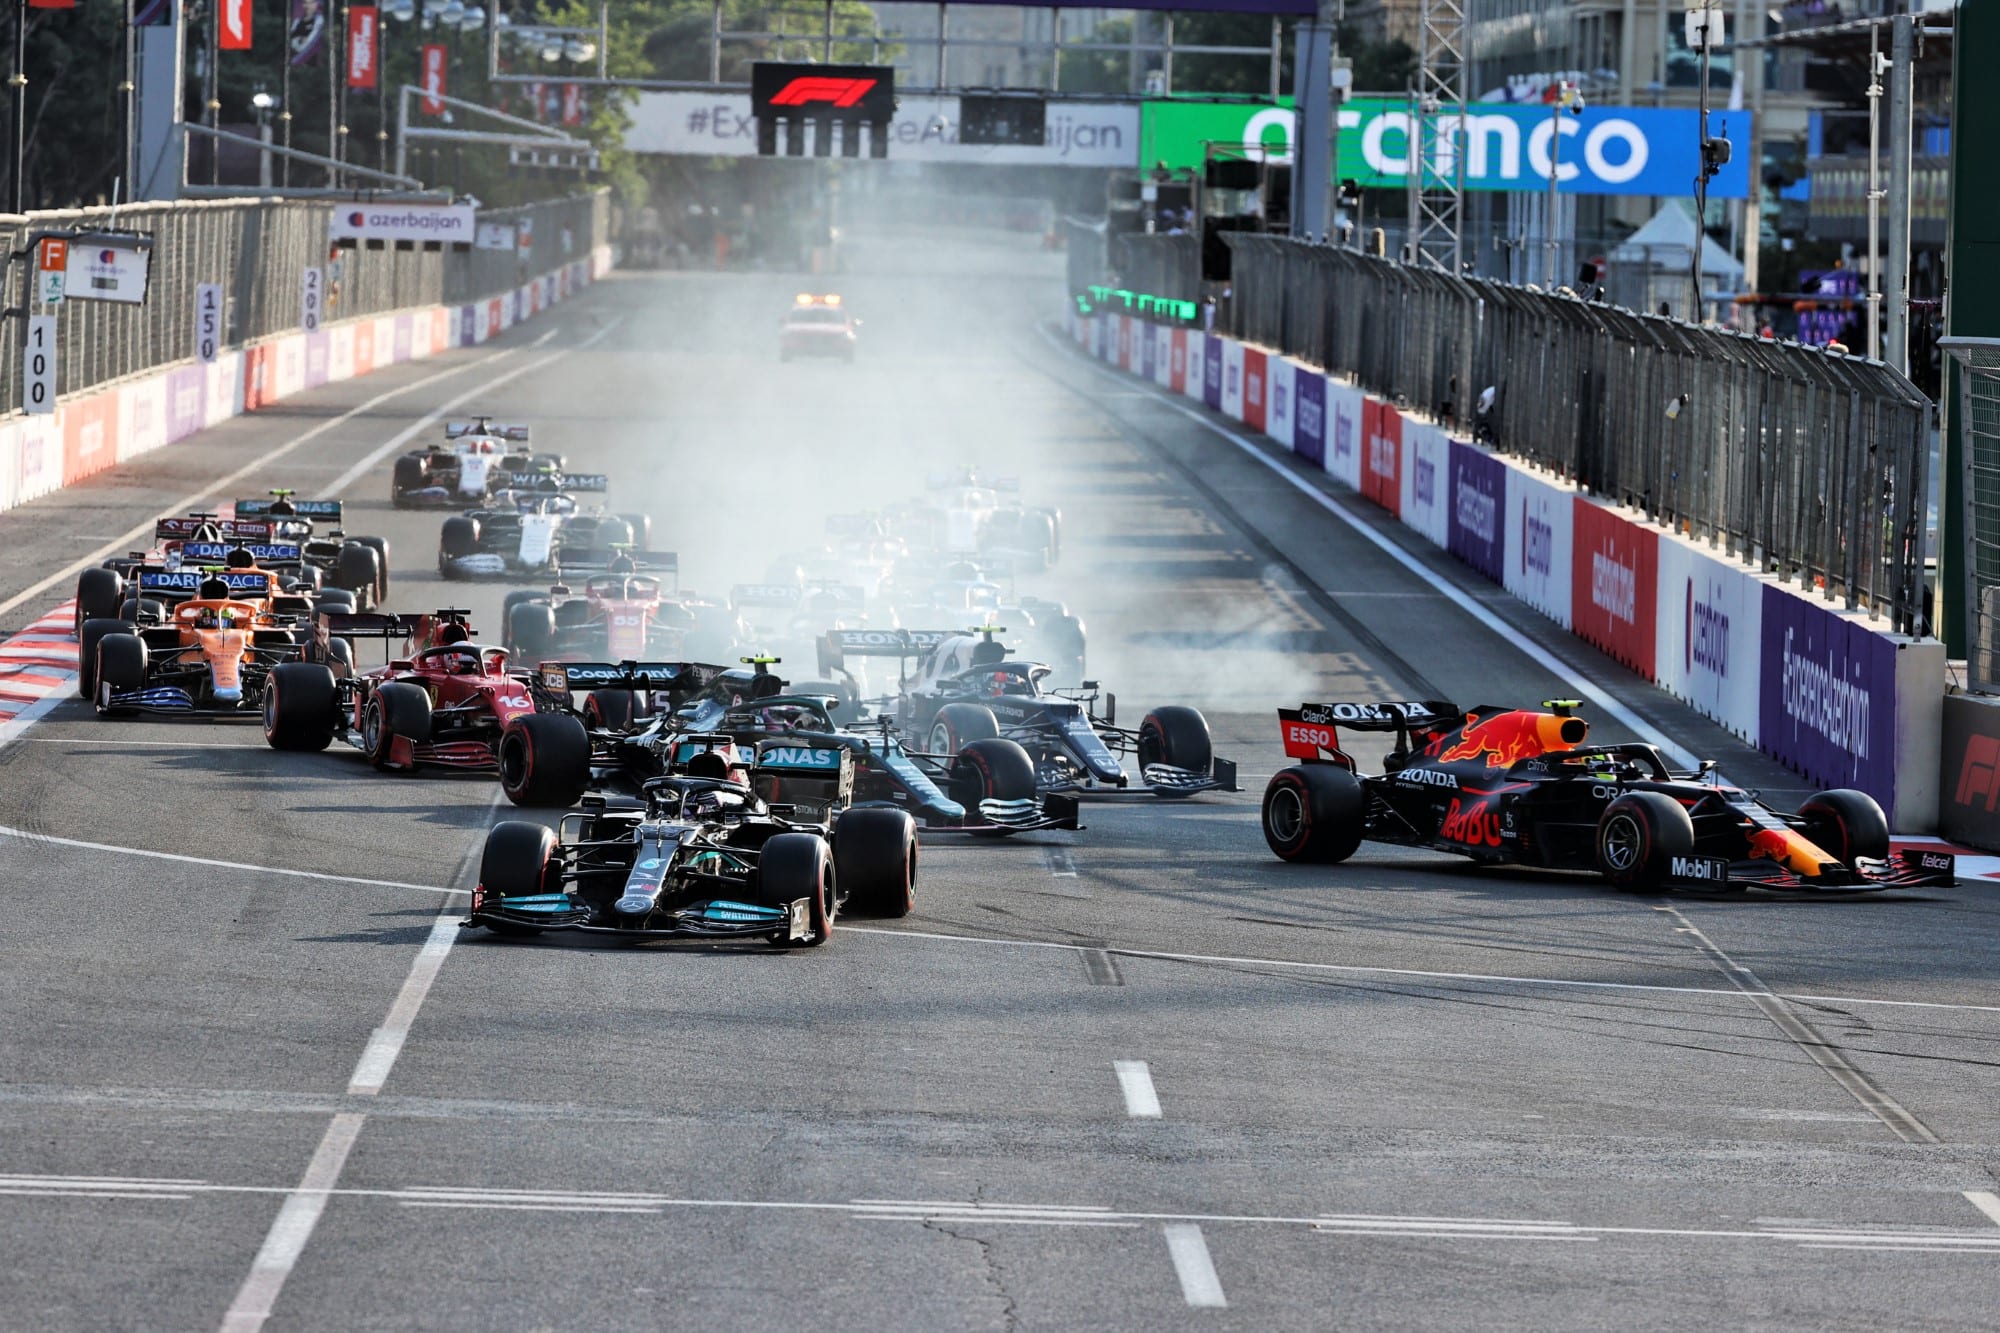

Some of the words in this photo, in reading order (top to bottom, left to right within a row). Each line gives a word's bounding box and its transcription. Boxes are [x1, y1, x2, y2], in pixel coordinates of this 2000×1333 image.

[370, 211, 461, 232] azerbaijan
[46, 242, 62, 267] F
[306, 272, 317, 329] 200
[202, 290, 215, 359] 150
[32, 326, 45, 403] 100
[513, 475, 605, 488] WIAMS
[246, 501, 333, 513] PNAS
[201, 544, 298, 557] DARTRACE
[158, 574, 264, 587] DARRACE
[614, 616, 639, 625] 55
[842, 633, 943, 644] HONDA
[545, 673, 564, 688] JCB
[567, 667, 676, 684] Cogniant
[499, 696, 530, 709] 16
[1321, 702, 1436, 719] ONDA
[1302, 709, 1330, 724] Claro
[1290, 726, 1330, 746] ESSO
[693, 745, 831, 765] PRONAS
[1527, 760, 1550, 772] citrix
[1397, 768, 1459, 789] HONDA
[1592, 785, 1640, 800] ORA
[1672, 856, 1710, 879] Mobil
[1921, 853, 1950, 870] telcel
[718, 902, 760, 912] PETRONAS
